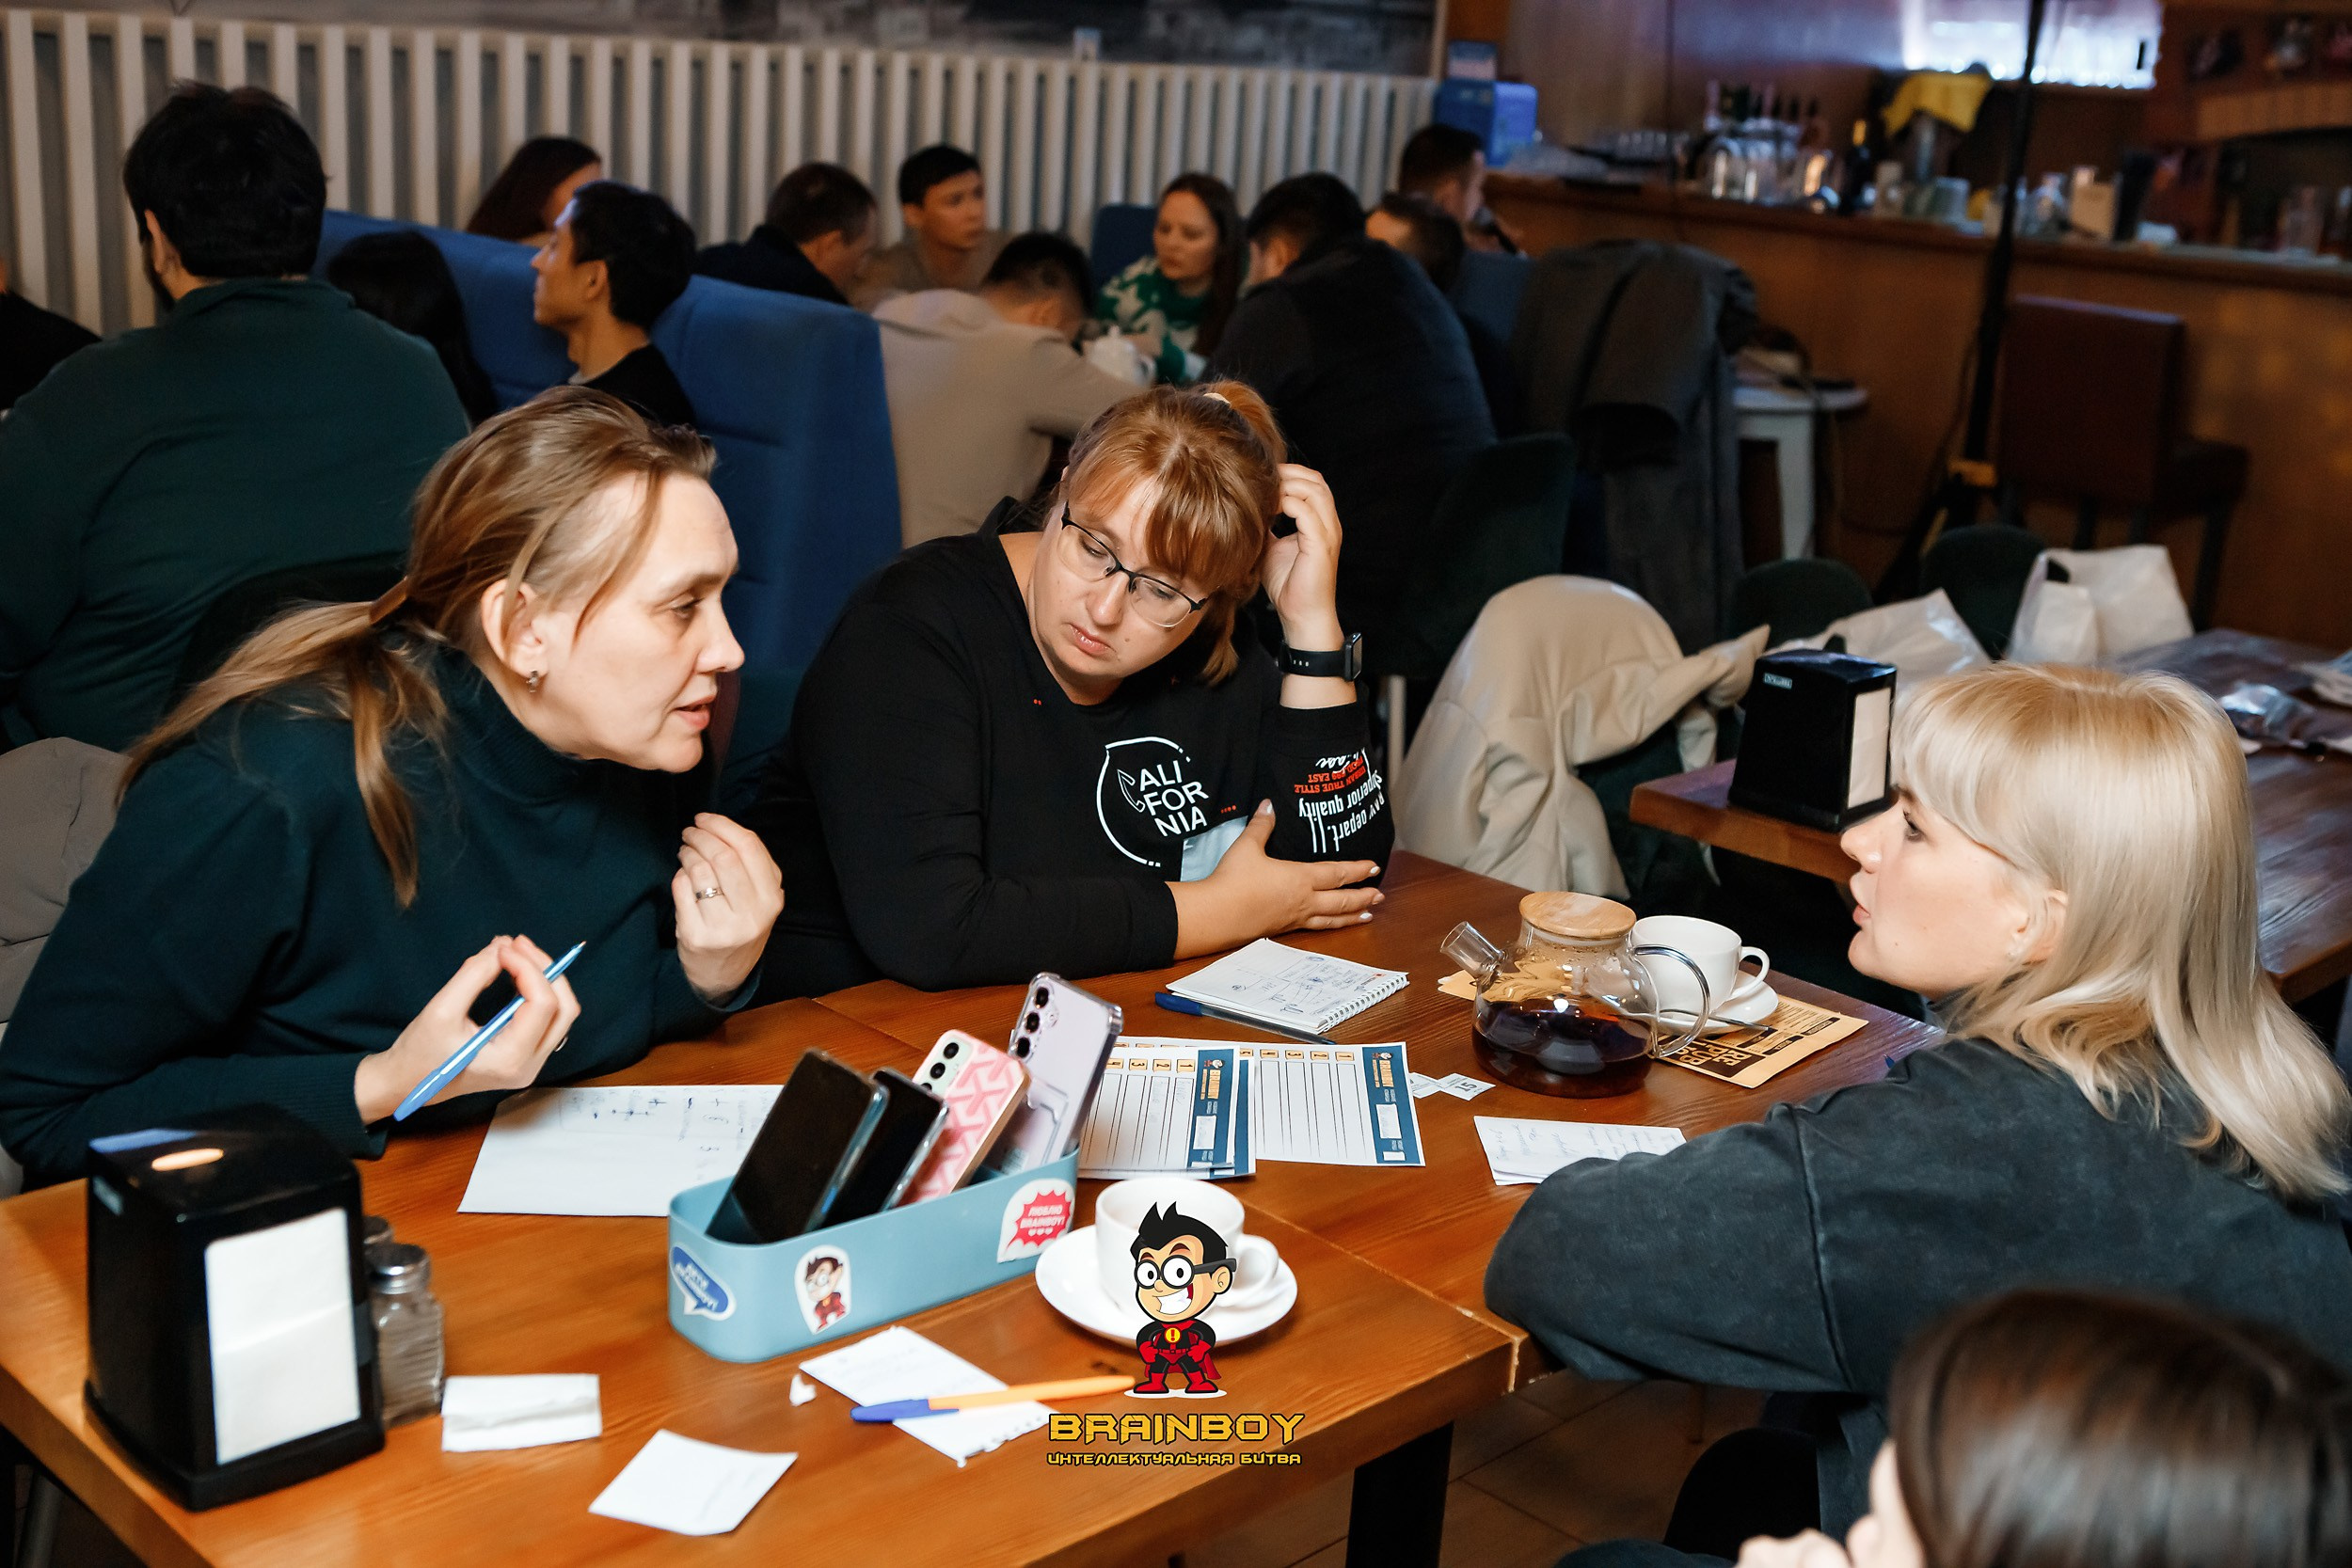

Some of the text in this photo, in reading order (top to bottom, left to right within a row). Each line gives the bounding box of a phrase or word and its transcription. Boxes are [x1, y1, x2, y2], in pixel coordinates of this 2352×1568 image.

[1308, 772, 1330, 783] EAST
[1294, 784, 1321, 794] STYLE
[1322, 780, 1345, 793] TRUE
[1143, 781, 1209, 816] FOR
[1154, 806, 1208, 837] NIA
[1299, 794, 1344, 853] quality
[1679, 1044, 1728, 1066] PUB
[1712, 1050, 1752, 1067] RE
[1454, 1082, 1477, 1092] 15
